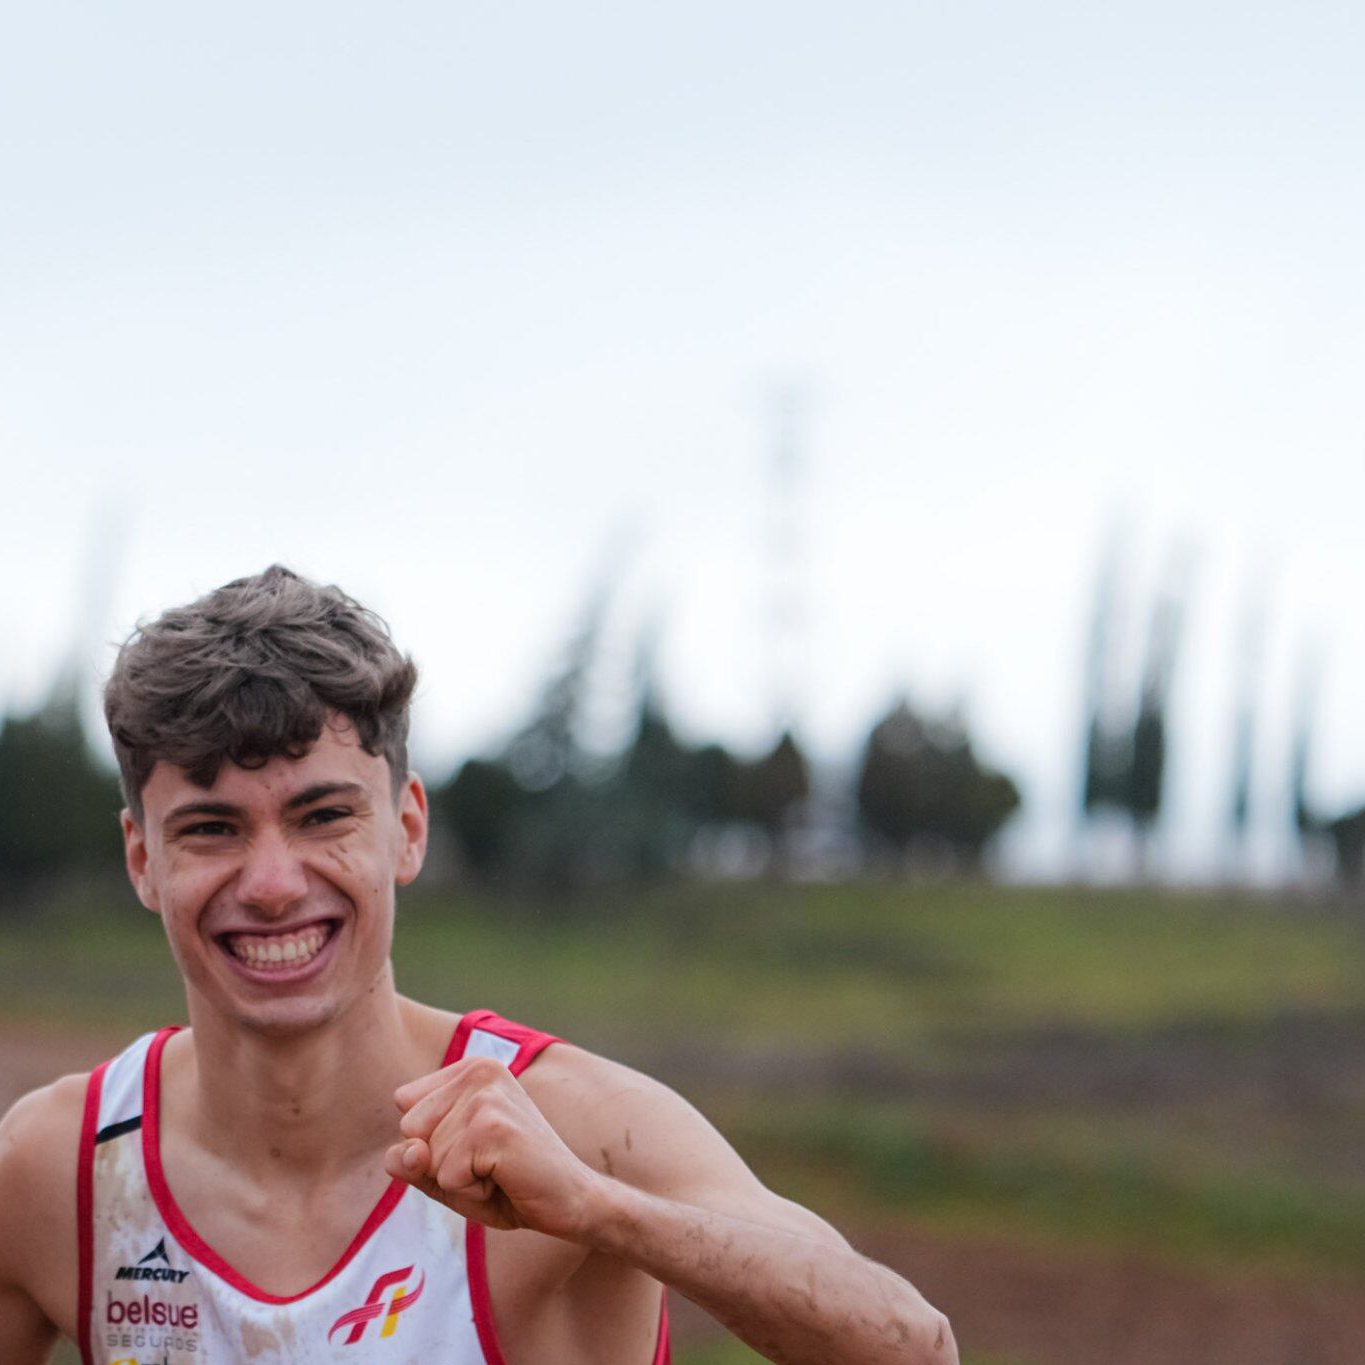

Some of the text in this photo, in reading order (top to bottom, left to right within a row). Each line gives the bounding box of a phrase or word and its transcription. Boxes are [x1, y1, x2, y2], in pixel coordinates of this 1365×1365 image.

[115, 1267, 189, 1283] MERCURY
[107, 1290, 198, 1329] belsue
[107, 1334, 198, 1352] SEGUROS
